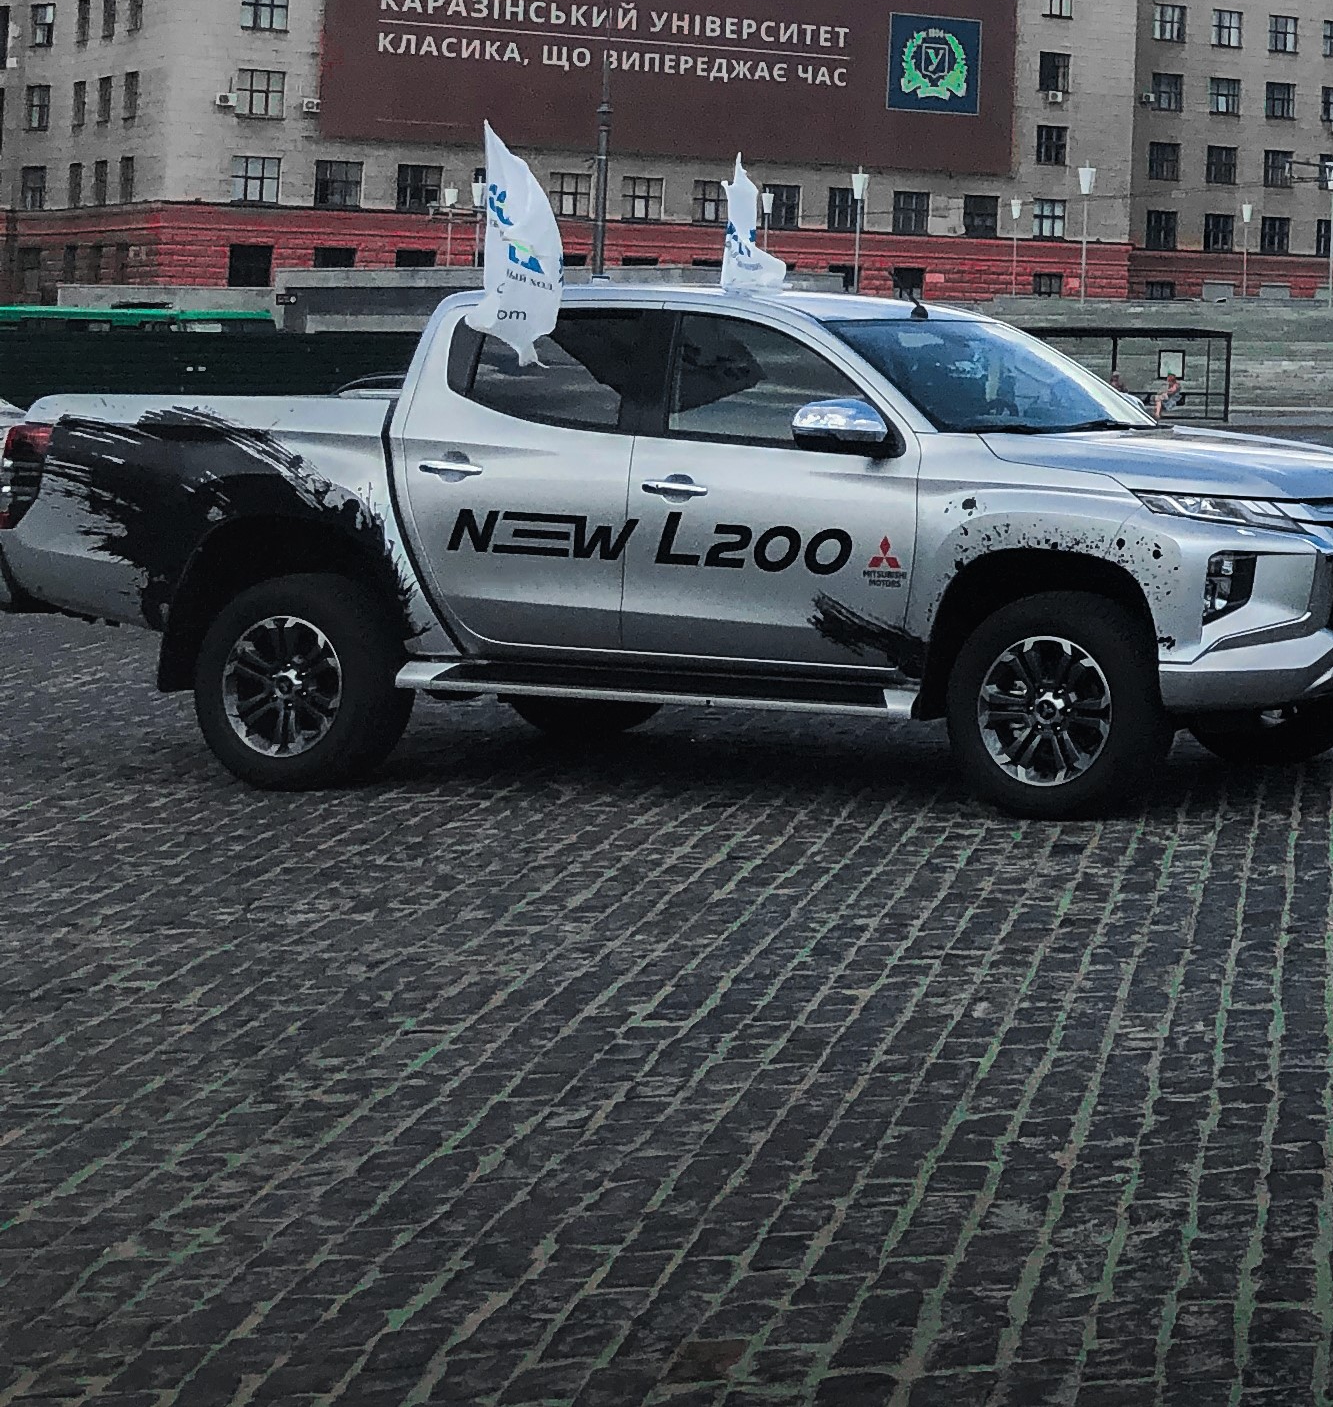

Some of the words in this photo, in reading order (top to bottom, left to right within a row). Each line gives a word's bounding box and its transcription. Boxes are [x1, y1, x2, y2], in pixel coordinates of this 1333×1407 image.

[650, 11, 850, 48] УНІВЕРСИТЕТ
[377, 32, 530, 66] КЛАСИКА,
[542, 45, 591, 71] ЩО
[603, 49, 788, 83] ВИПЕРЕДЖАЄ
[798, 67, 848, 87] ЧАС
[447, 508, 639, 561] NEW
[655, 511, 854, 576] L200
